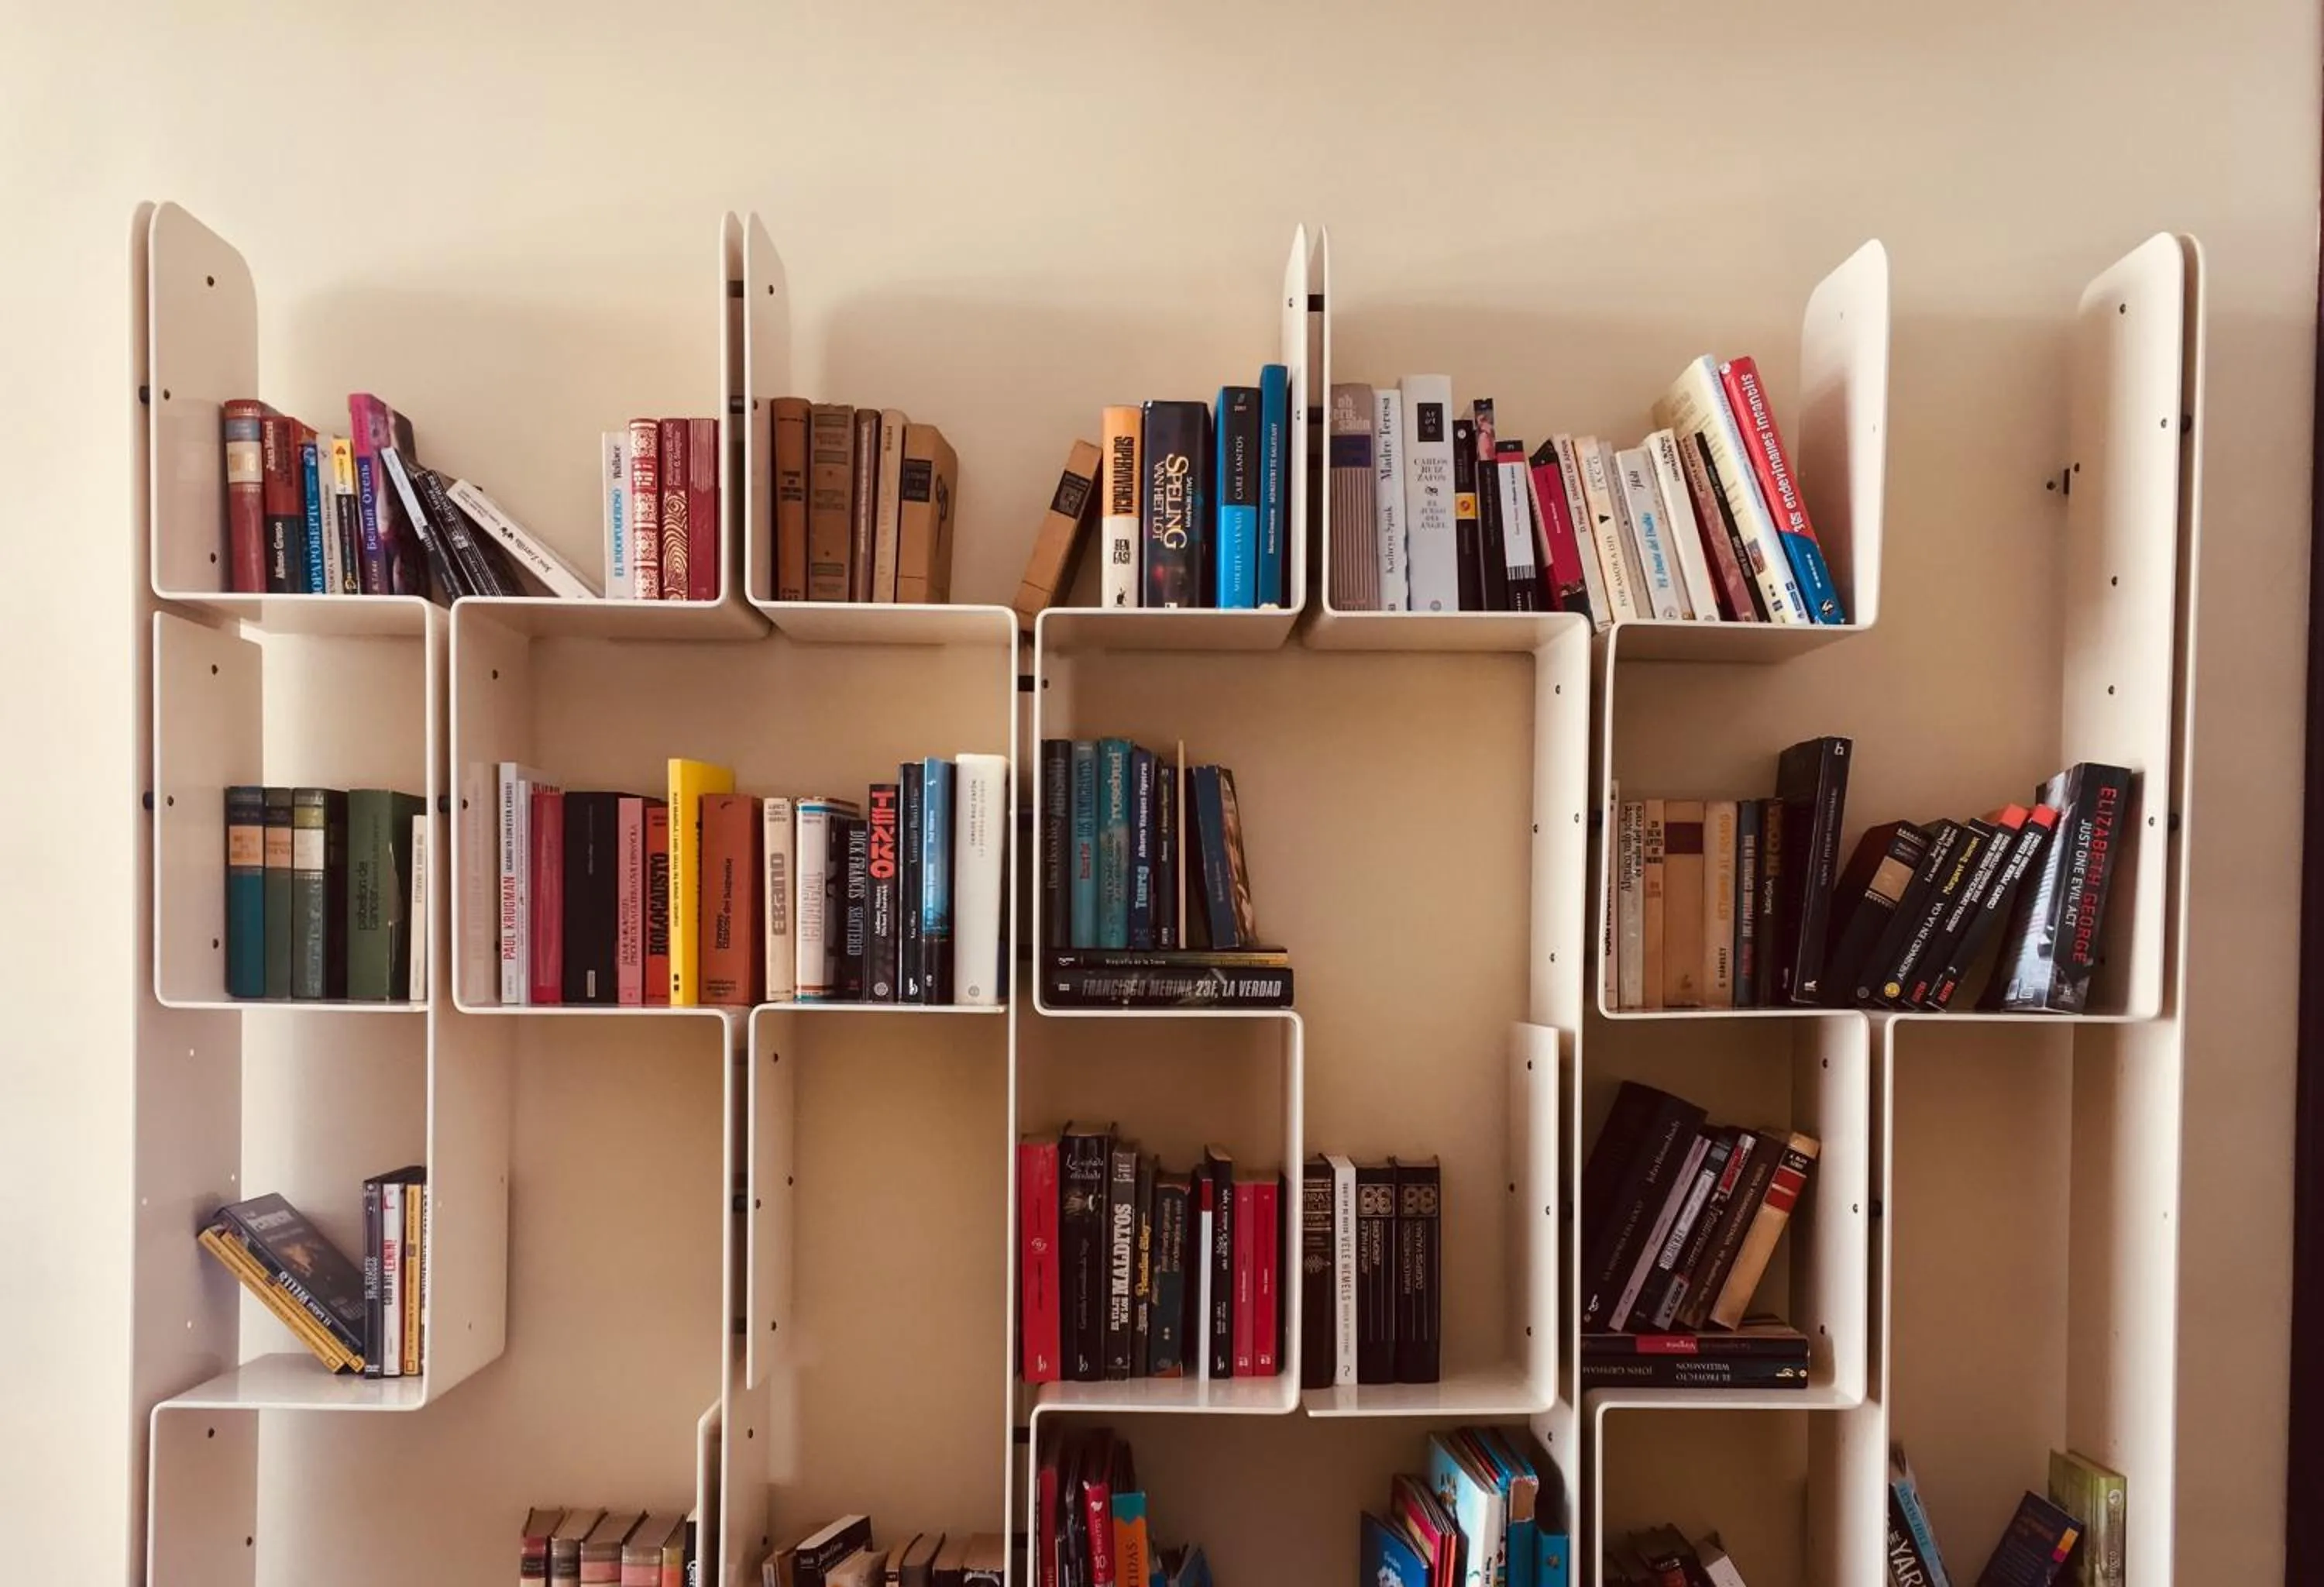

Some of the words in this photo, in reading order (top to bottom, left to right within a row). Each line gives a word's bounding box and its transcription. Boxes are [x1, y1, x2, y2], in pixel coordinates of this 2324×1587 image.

[1378, 396, 1392, 438] Teresa
[1153, 460, 1165, 486] VAN
[1234, 435, 1245, 473] SANTOS
[1379, 440, 1393, 480] Madre
[1113, 436, 1134, 515] SUPERVIVENCIA
[1234, 475, 1244, 500] CARE
[1153, 487, 1165, 512] HET
[1152, 516, 1164, 543] LOT
[1385, 535, 1396, 573] Kathryn
[849, 831, 866, 849] DICK
[2079, 818, 2093, 848] JUST
[2089, 786, 2118, 888] ELIZABETH
[848, 852, 866, 900] FRANCIS
[2074, 849, 2089, 873] ONE
[503, 876, 516, 930] KRUGMAN
[648, 852, 669, 956] HOLOCAUSTO
[1134, 865, 1150, 910] Tuareg
[2069, 873, 2085, 902] EVIL
[847, 907, 864, 956] SHATTERED
[1894, 938, 1923, 979] ASESINATO
[1917, 925, 1929, 939] EN
[1924, 914, 1936, 927] LA
[1930, 900, 1944, 916] CIA
[1941, 862, 1965, 896] Margaret
[2064, 904, 2077, 928] ACT
[2071, 890, 2099, 963] GEORGE
[503, 935, 516, 961] PAUL
[1081, 979, 1147, 997] FRANCISCO
[1239, 979, 1283, 998] VERDAD
[1112, 1203, 1132, 1295] MALDITOS
[1340, 1236, 1352, 1259] VELE
[1340, 1263, 1352, 1302] HEMELS
